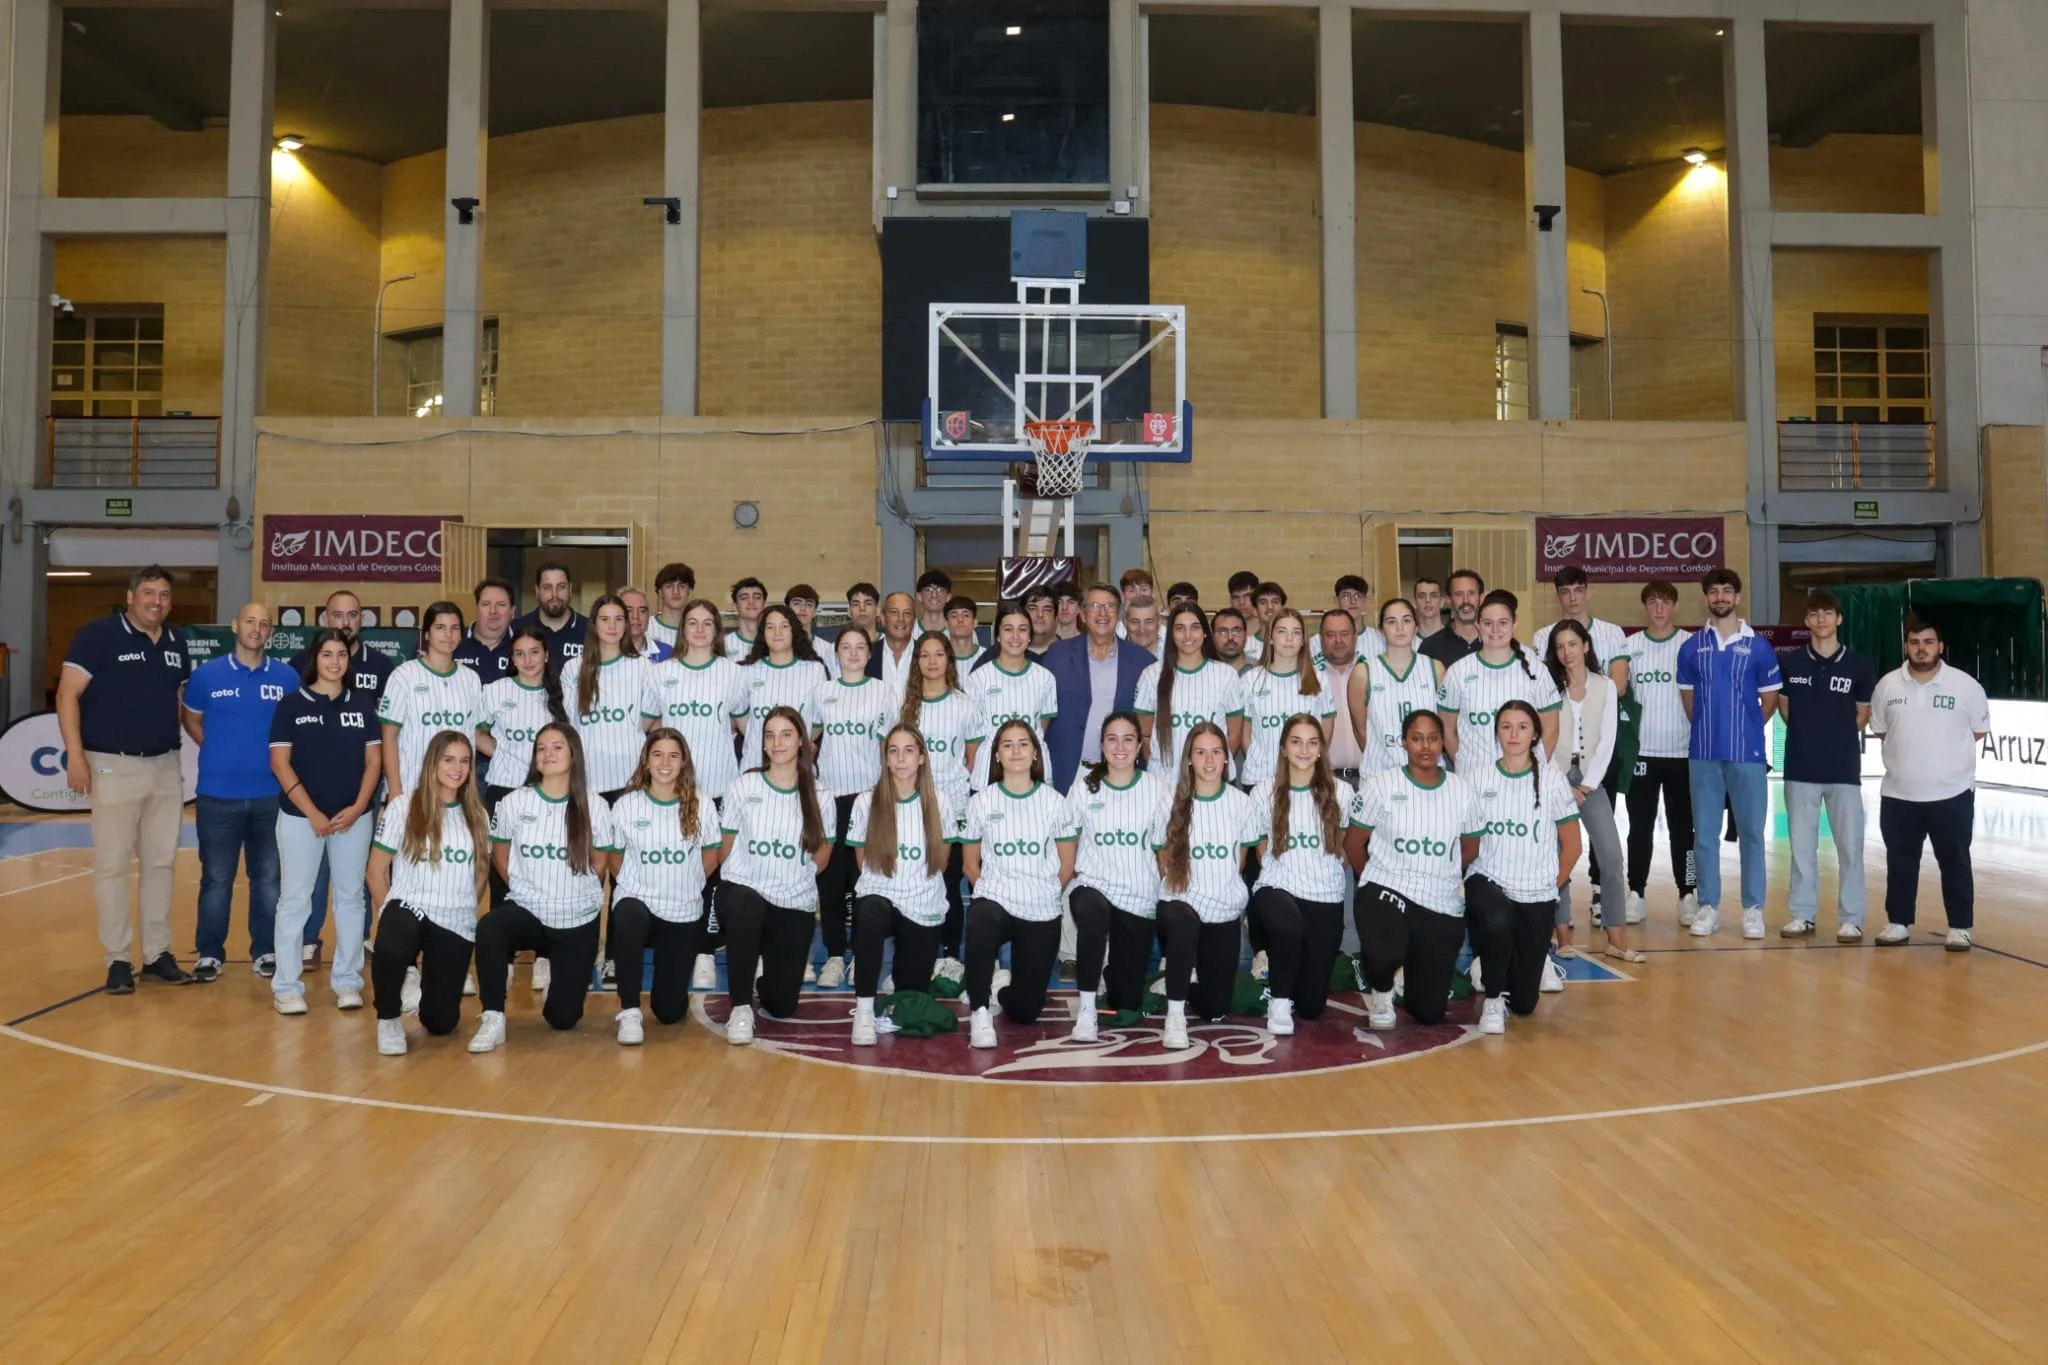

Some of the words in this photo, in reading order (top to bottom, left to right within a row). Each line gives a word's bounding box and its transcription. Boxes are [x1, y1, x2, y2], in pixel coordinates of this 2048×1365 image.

[1584, 532, 1717, 559] IMDECO
[271, 562, 308, 572] Instituto
[310, 562, 355, 574] Municipal
[357, 562, 369, 572] de
[371, 563, 413, 574] Deportes
[1582, 563, 1624, 574] Municipal
[1626, 563, 1637, 573] de
[1639, 564, 1679, 574] Deportes
[355, 673, 378, 690] CCB
[1636, 669, 1672, 684] coto
[1829, 676, 1853, 694] CCB
[260, 684, 284, 702] CCB
[1933, 694, 1956, 710] CCB
[340, 712, 365, 728] CCB
[1285, 832, 1320, 849] oto
[1191, 842, 1229, 860] oto
